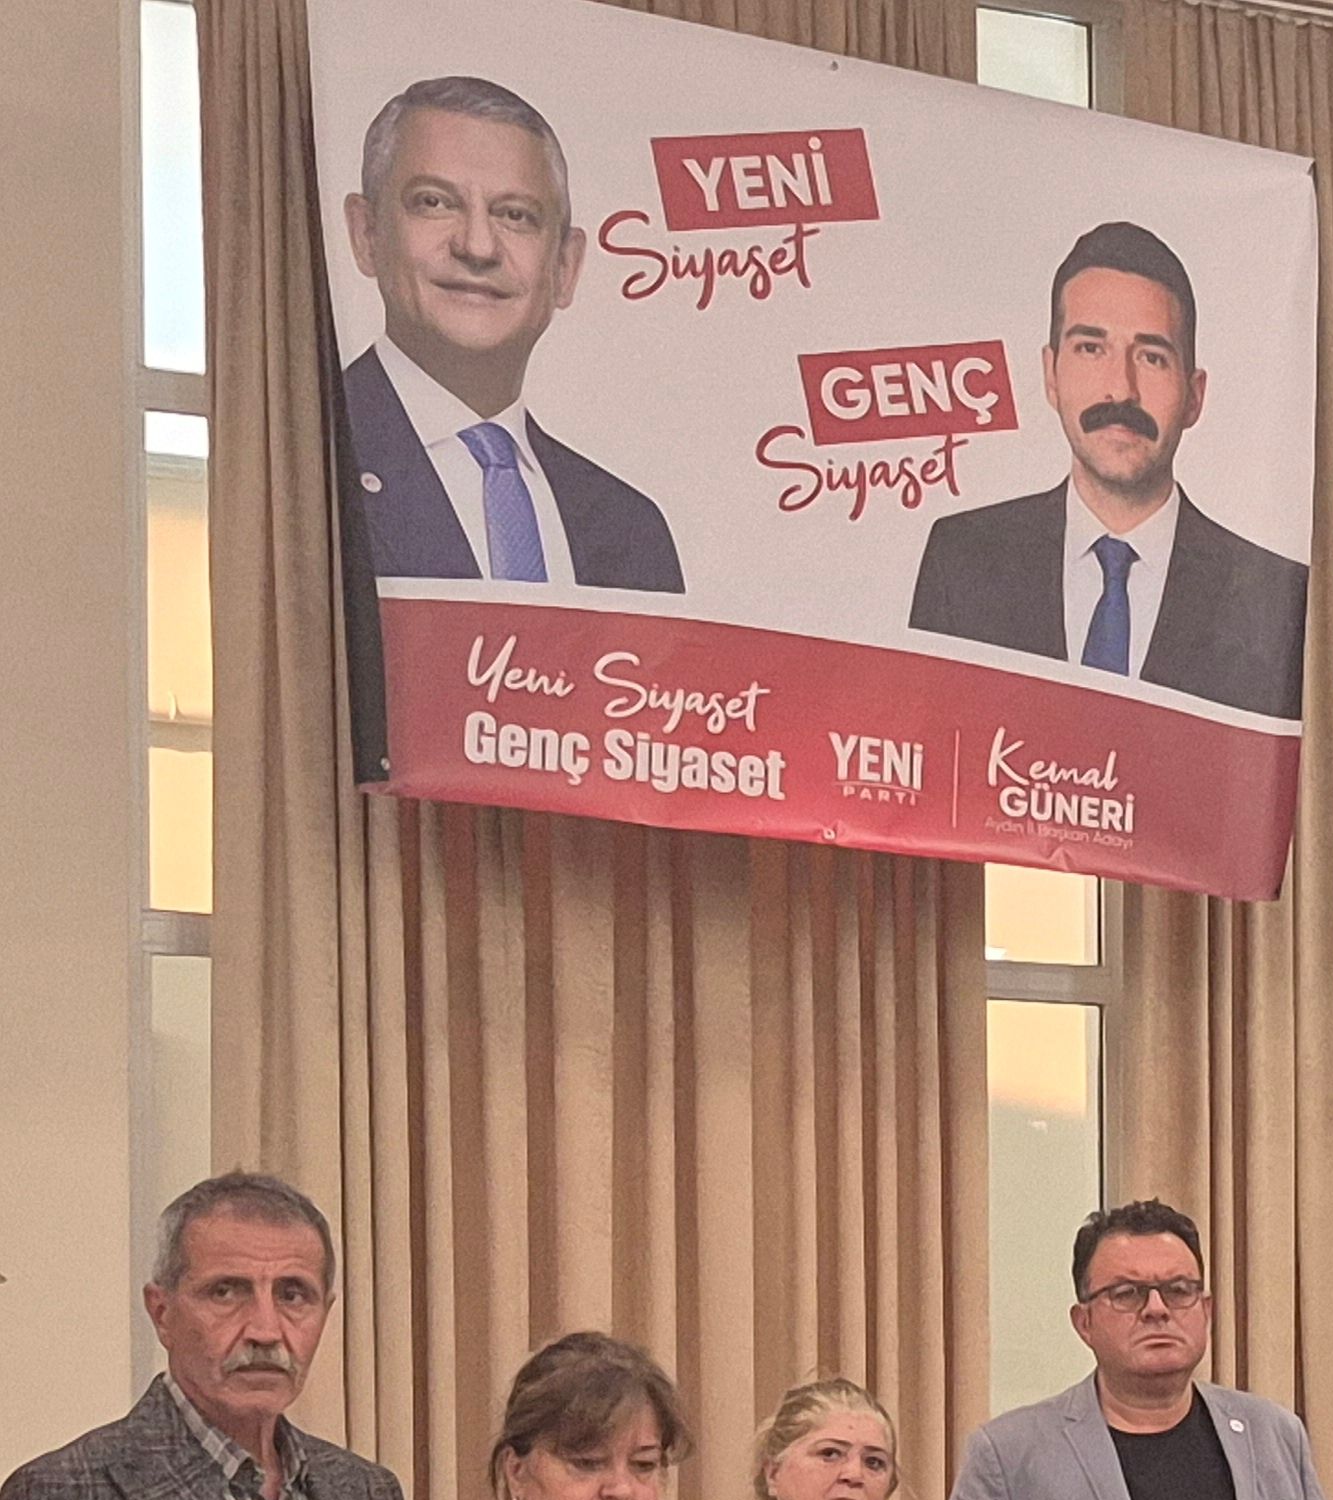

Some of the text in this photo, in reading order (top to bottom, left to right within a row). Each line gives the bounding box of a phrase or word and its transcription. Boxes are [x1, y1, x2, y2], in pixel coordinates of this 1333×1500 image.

[682, 136, 832, 212] YENİ
[598, 210, 820, 311] Siyaset
[820, 356, 999, 426] GENÇ
[755, 425, 969, 521] Siyaset
[467, 635, 770, 734] Yeni Siyaset
[464, 711, 786, 800] Genç Siyaset
[828, 731, 924, 791] YENİ
[987, 726, 1118, 791] Kemal
[999, 783, 1135, 833] GÜNERİ
